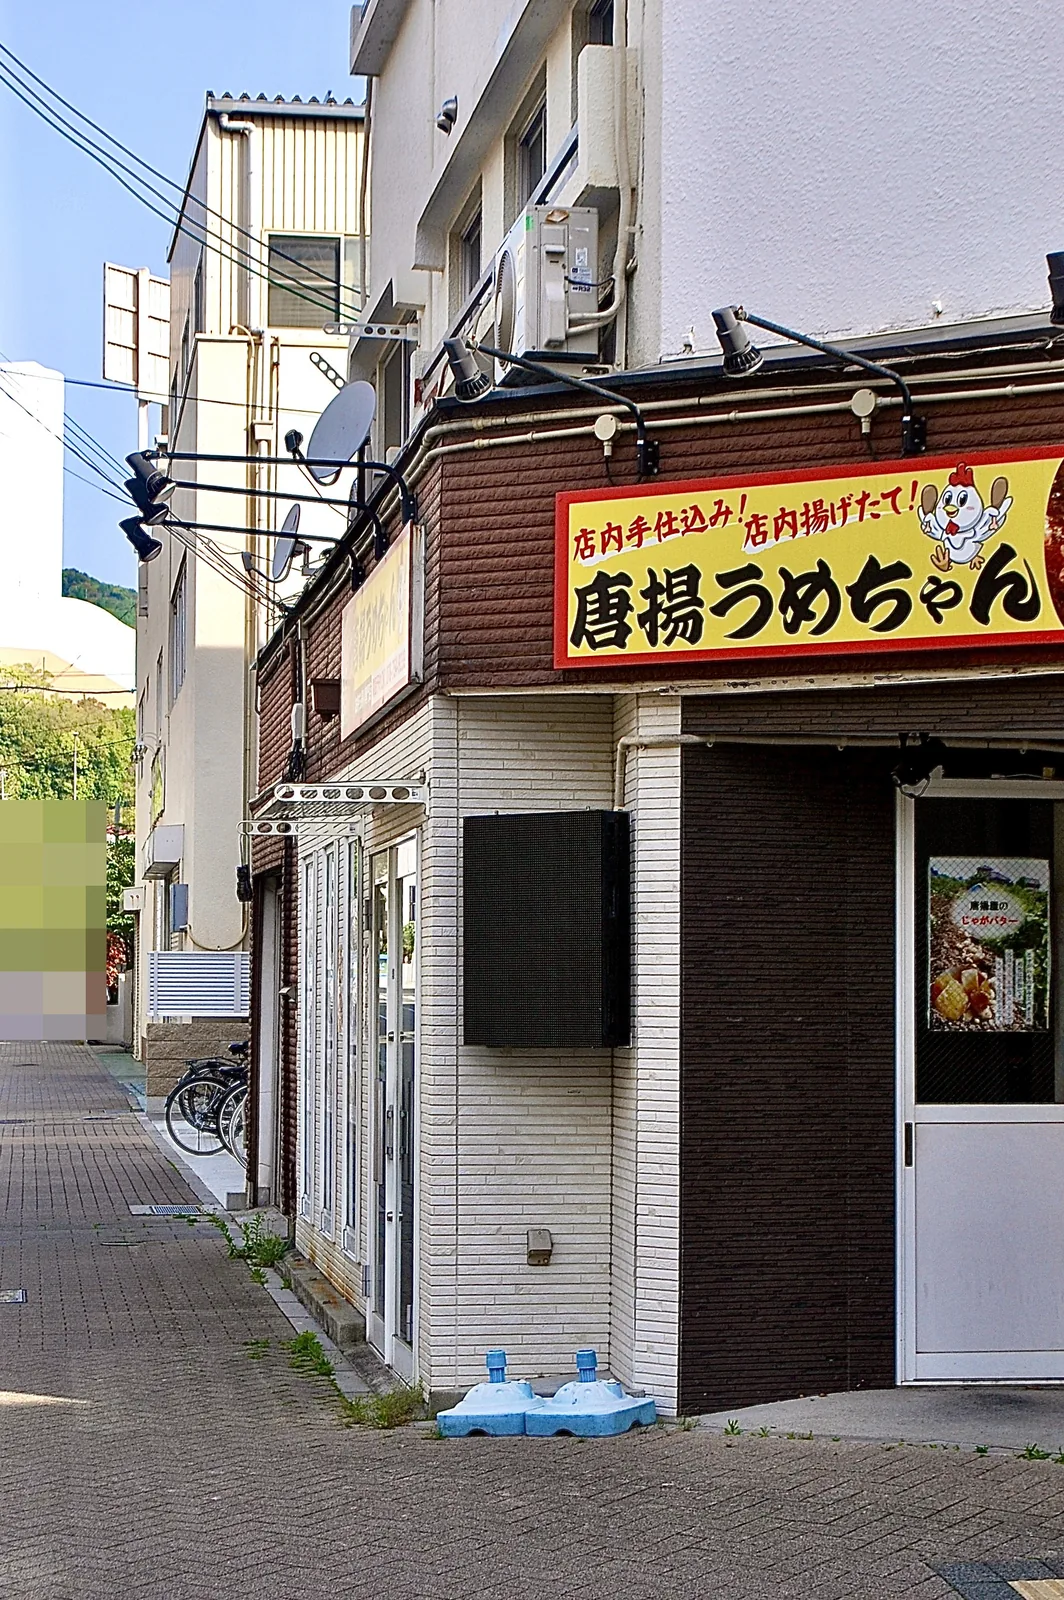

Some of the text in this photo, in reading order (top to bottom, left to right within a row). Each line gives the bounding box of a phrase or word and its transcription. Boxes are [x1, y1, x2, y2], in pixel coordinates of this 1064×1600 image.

[573, 480, 918, 561] 店内手仕込み! 店内揚げたて!
[570, 543, 1041, 651] 唐揚うめちゃん
[962, 915, 1018, 927] じゃがバター
